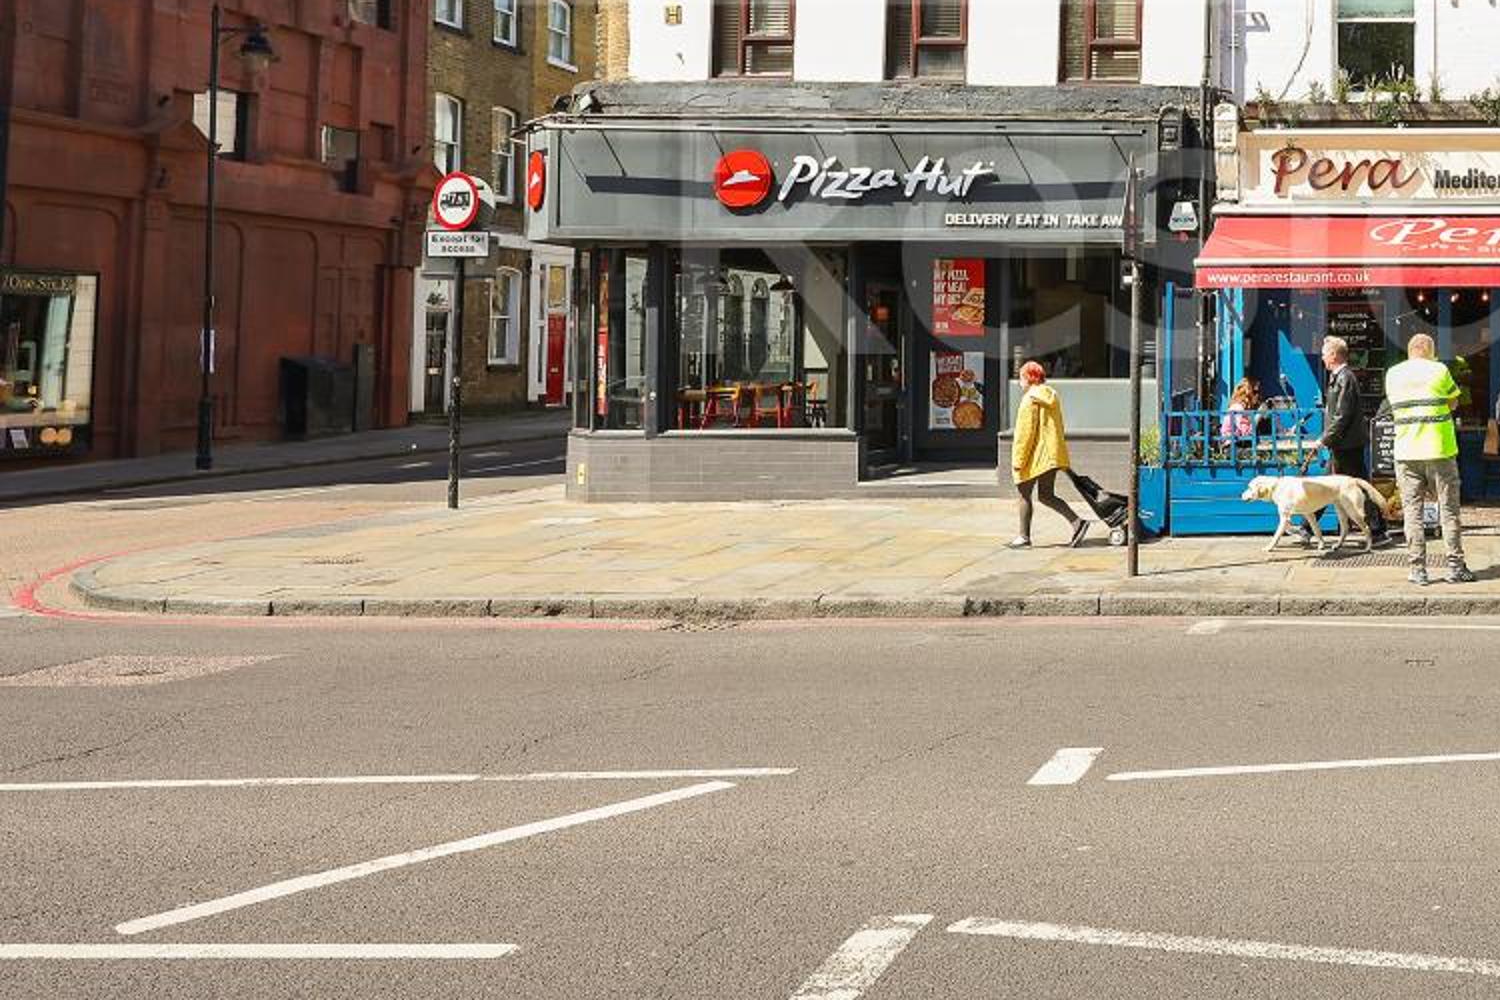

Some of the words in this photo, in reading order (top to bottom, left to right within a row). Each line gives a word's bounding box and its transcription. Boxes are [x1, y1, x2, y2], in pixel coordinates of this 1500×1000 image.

[1271, 147, 1419, 194] Pera
[778, 155, 898, 201] Pizza
[904, 155, 994, 197] Hut
[945, 213, 1009, 225] DELIVERY
[1016, 213, 1039, 225] EAT
[1042, 213, 1059, 225] IN
[1066, 213, 1099, 225] TAKE
[1101, 213, 1123, 225] AW
[441, 245, 476, 253] access
[1207, 270, 1371, 284] www.perarestaurant.co.uk
